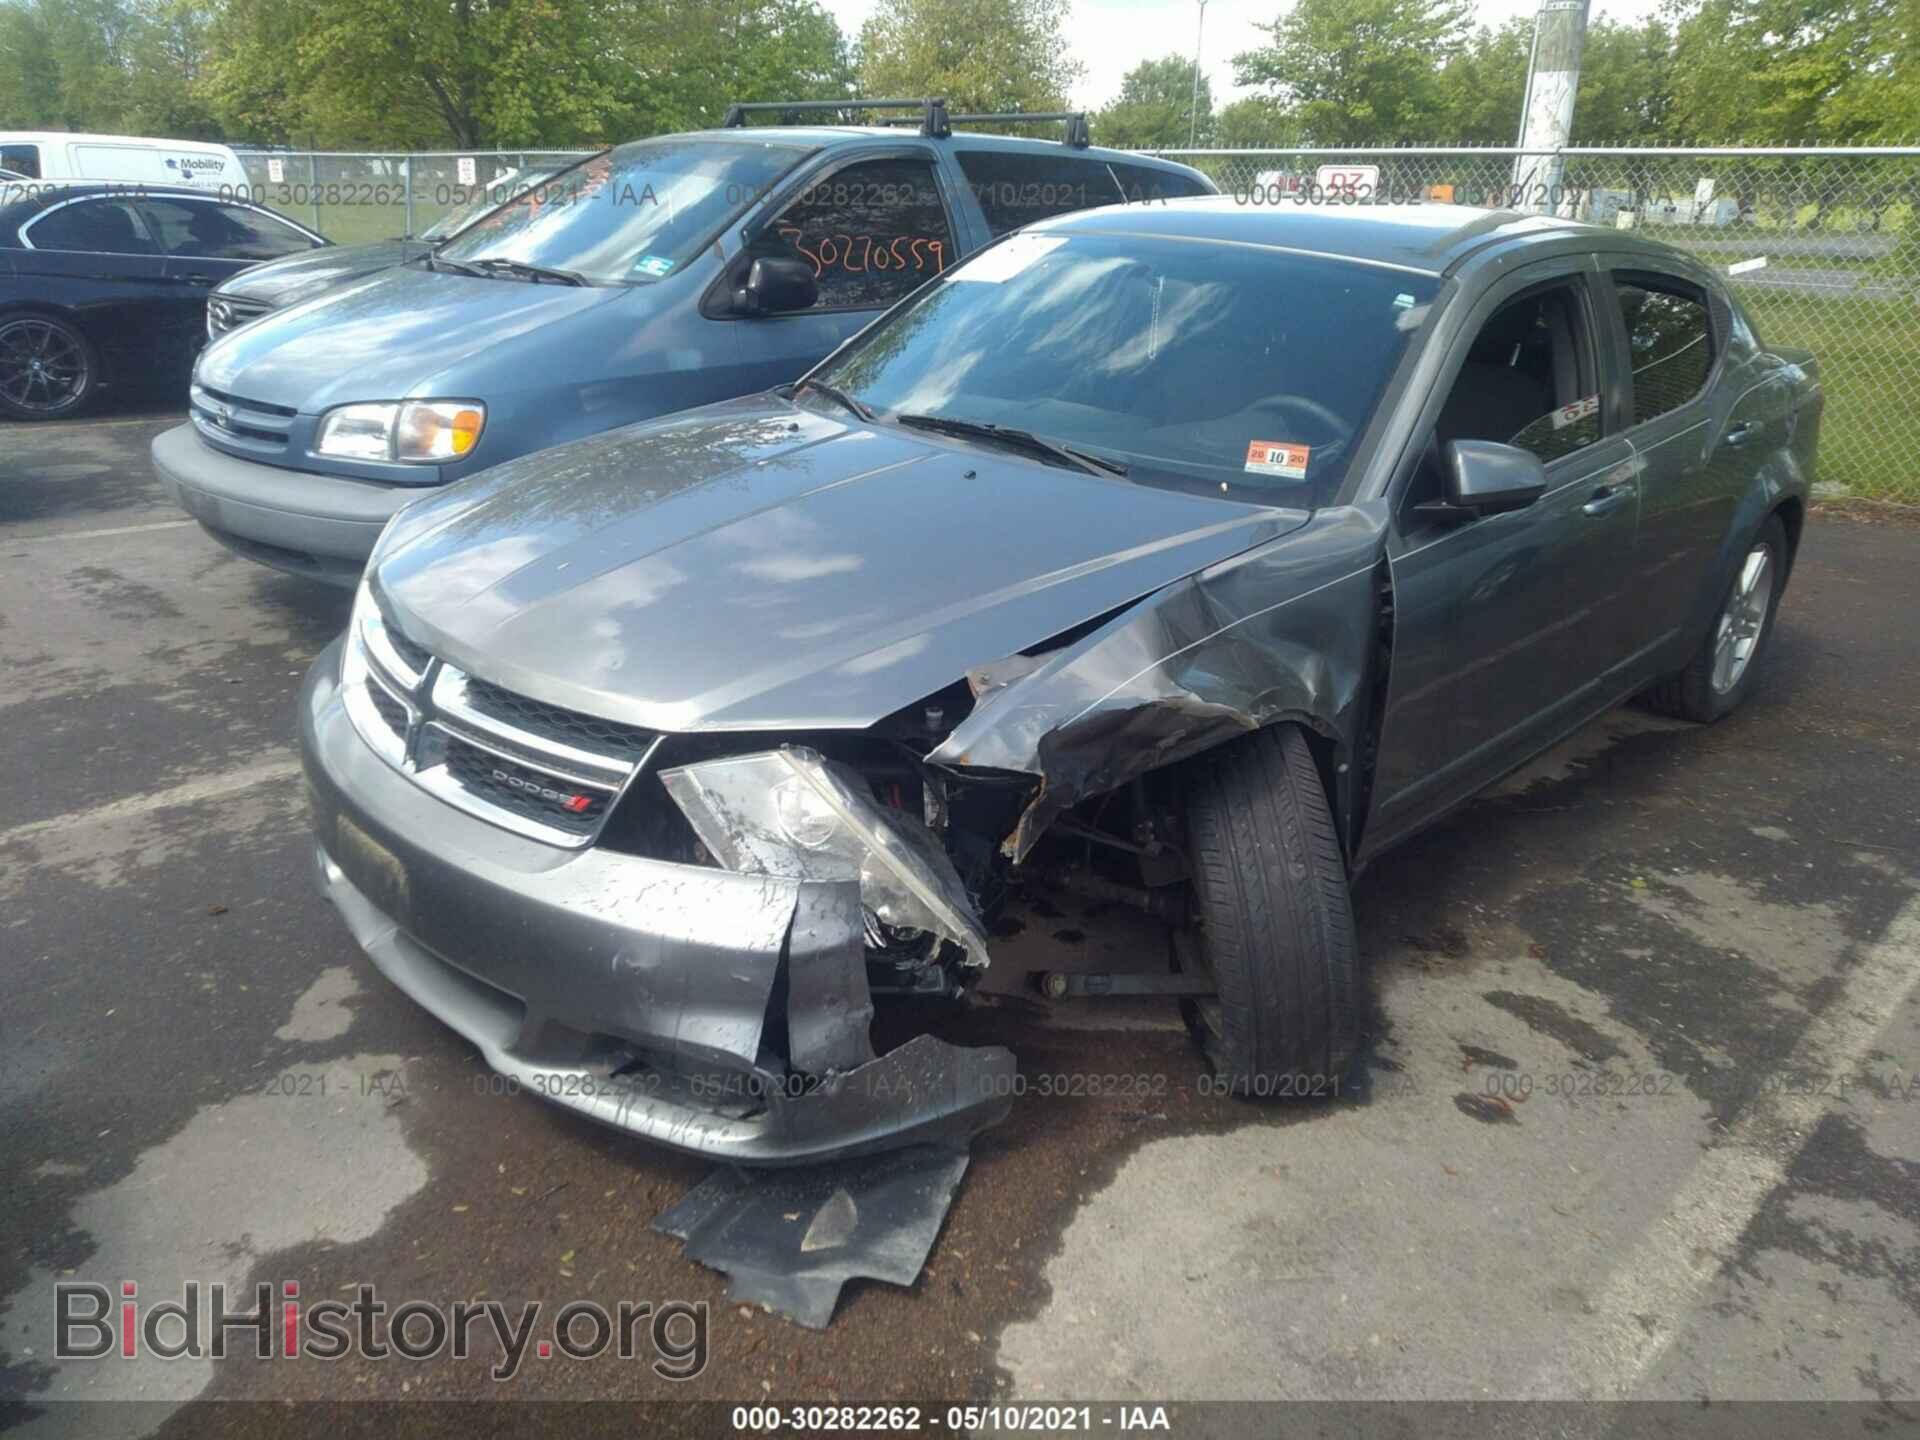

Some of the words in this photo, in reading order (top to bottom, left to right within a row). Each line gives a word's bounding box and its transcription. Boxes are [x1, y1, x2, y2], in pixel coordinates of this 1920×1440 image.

[180, 158, 225, 172] Mobility
[779, 228, 944, 279] 30270559
[1269, 451, 1285, 464] 10
[493, 769, 572, 804] DODGE
